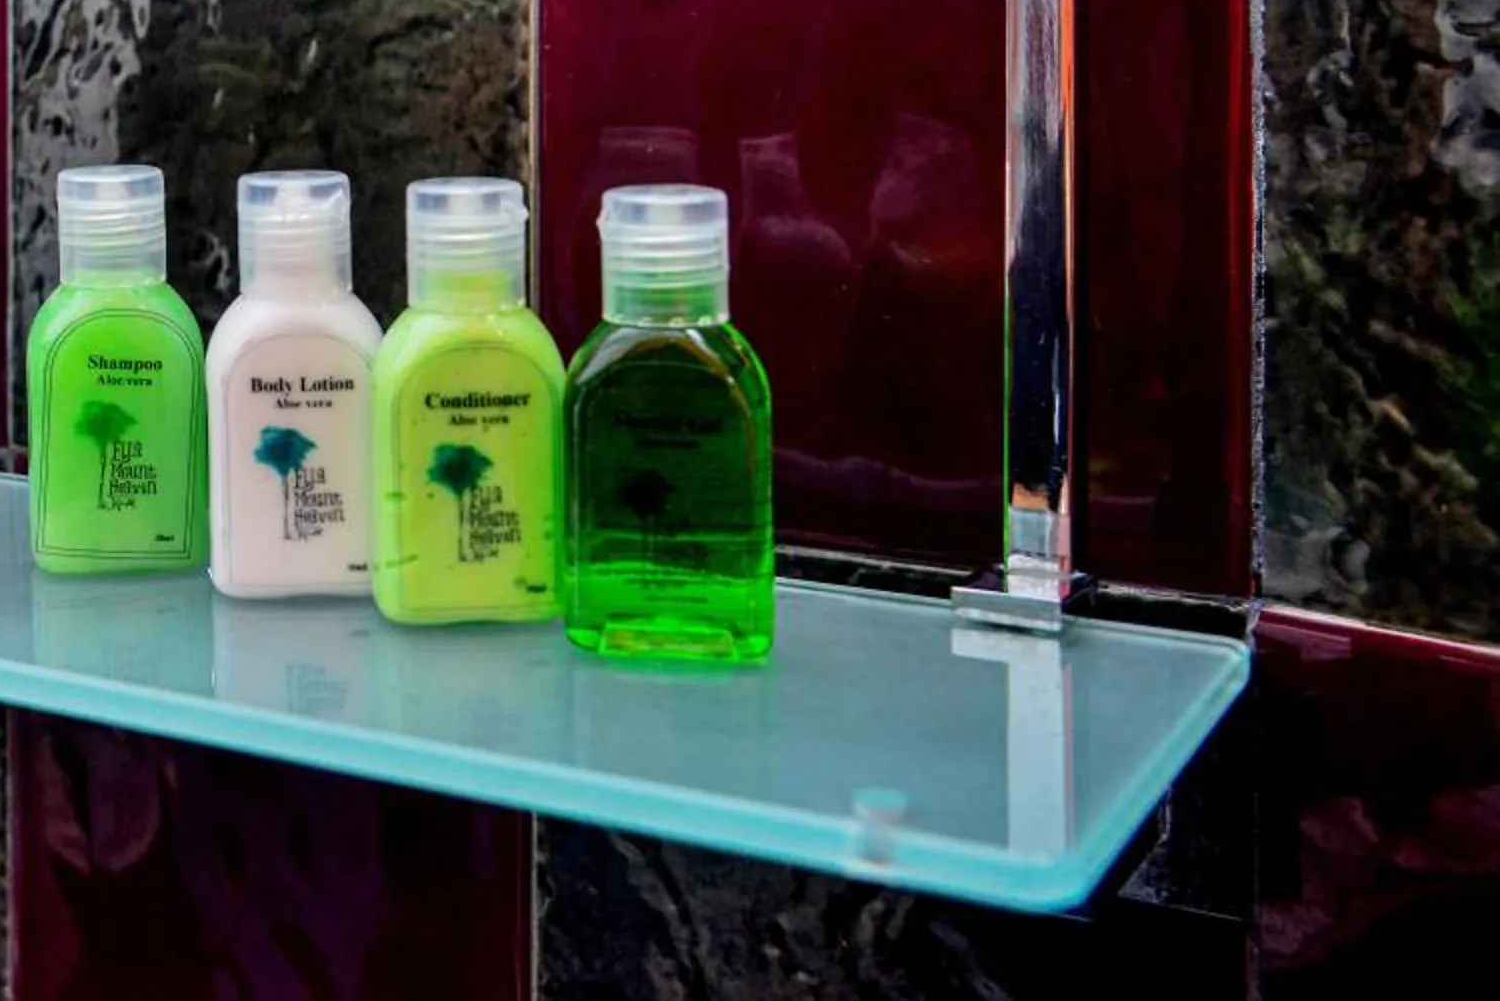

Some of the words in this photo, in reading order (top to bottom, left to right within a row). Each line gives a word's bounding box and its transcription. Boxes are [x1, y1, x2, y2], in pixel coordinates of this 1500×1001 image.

[86, 353, 163, 374] Shampoo
[97, 374, 125, 386] Aloe
[126, 375, 153, 386] vera
[250, 377, 292, 396] Body
[299, 376, 355, 392] Lotion
[273, 398, 301, 409] Aloe
[424, 391, 532, 410] Conditioner
